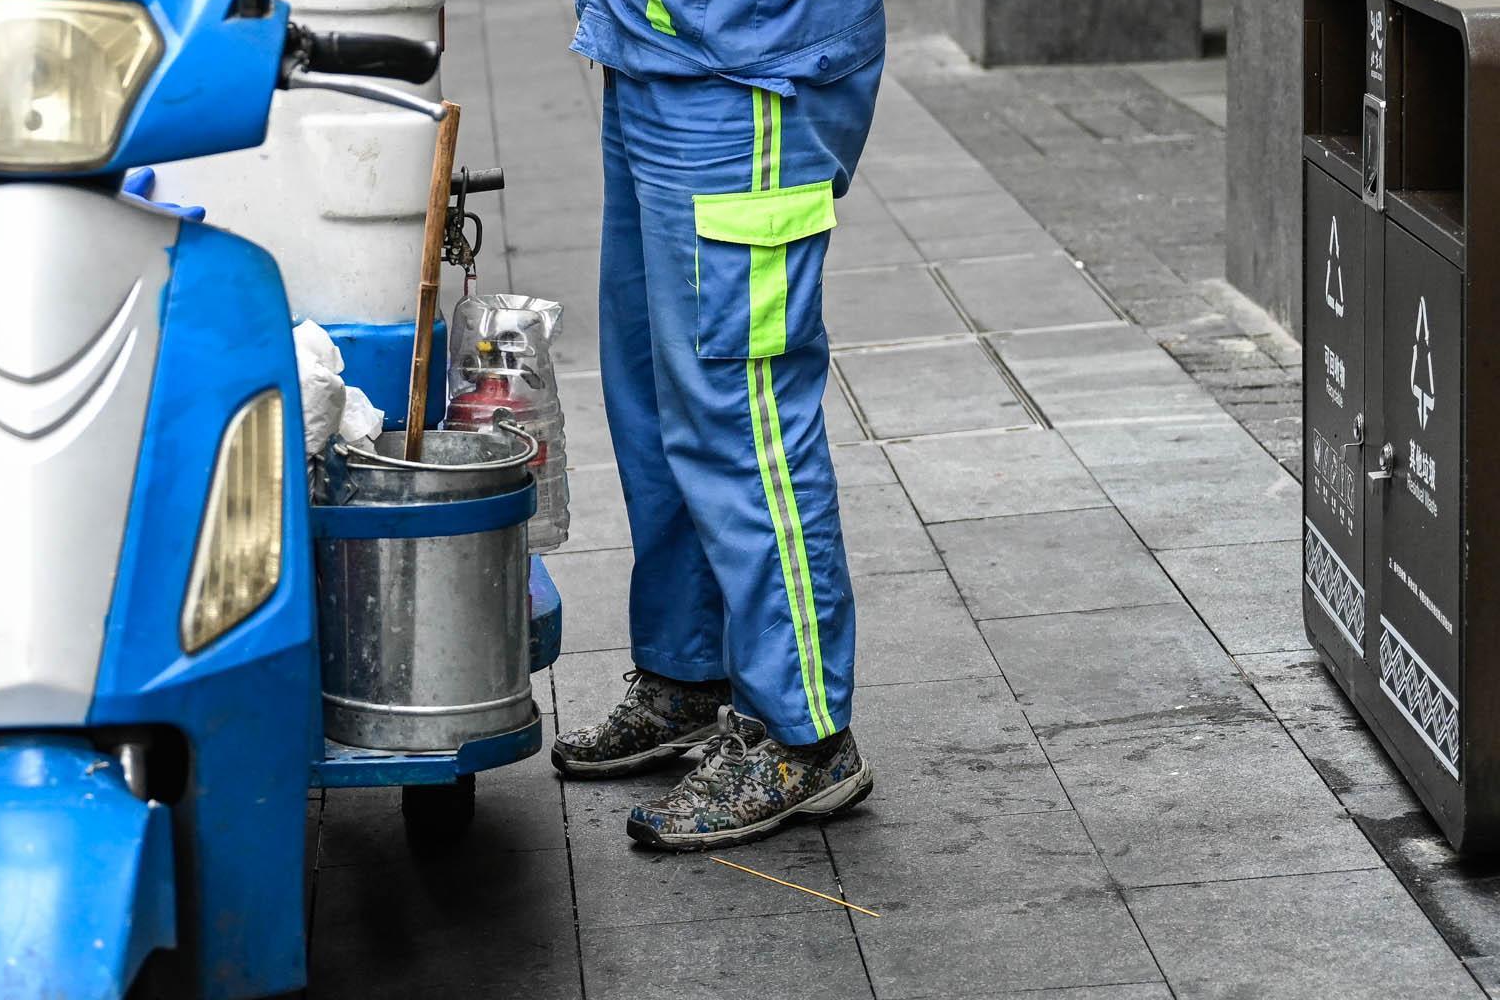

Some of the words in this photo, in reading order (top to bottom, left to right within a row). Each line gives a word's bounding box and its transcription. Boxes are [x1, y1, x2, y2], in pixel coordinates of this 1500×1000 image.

[1324, 344, 1346, 390] 可回收物
[1409, 438, 1436, 492] 其他垃圾
